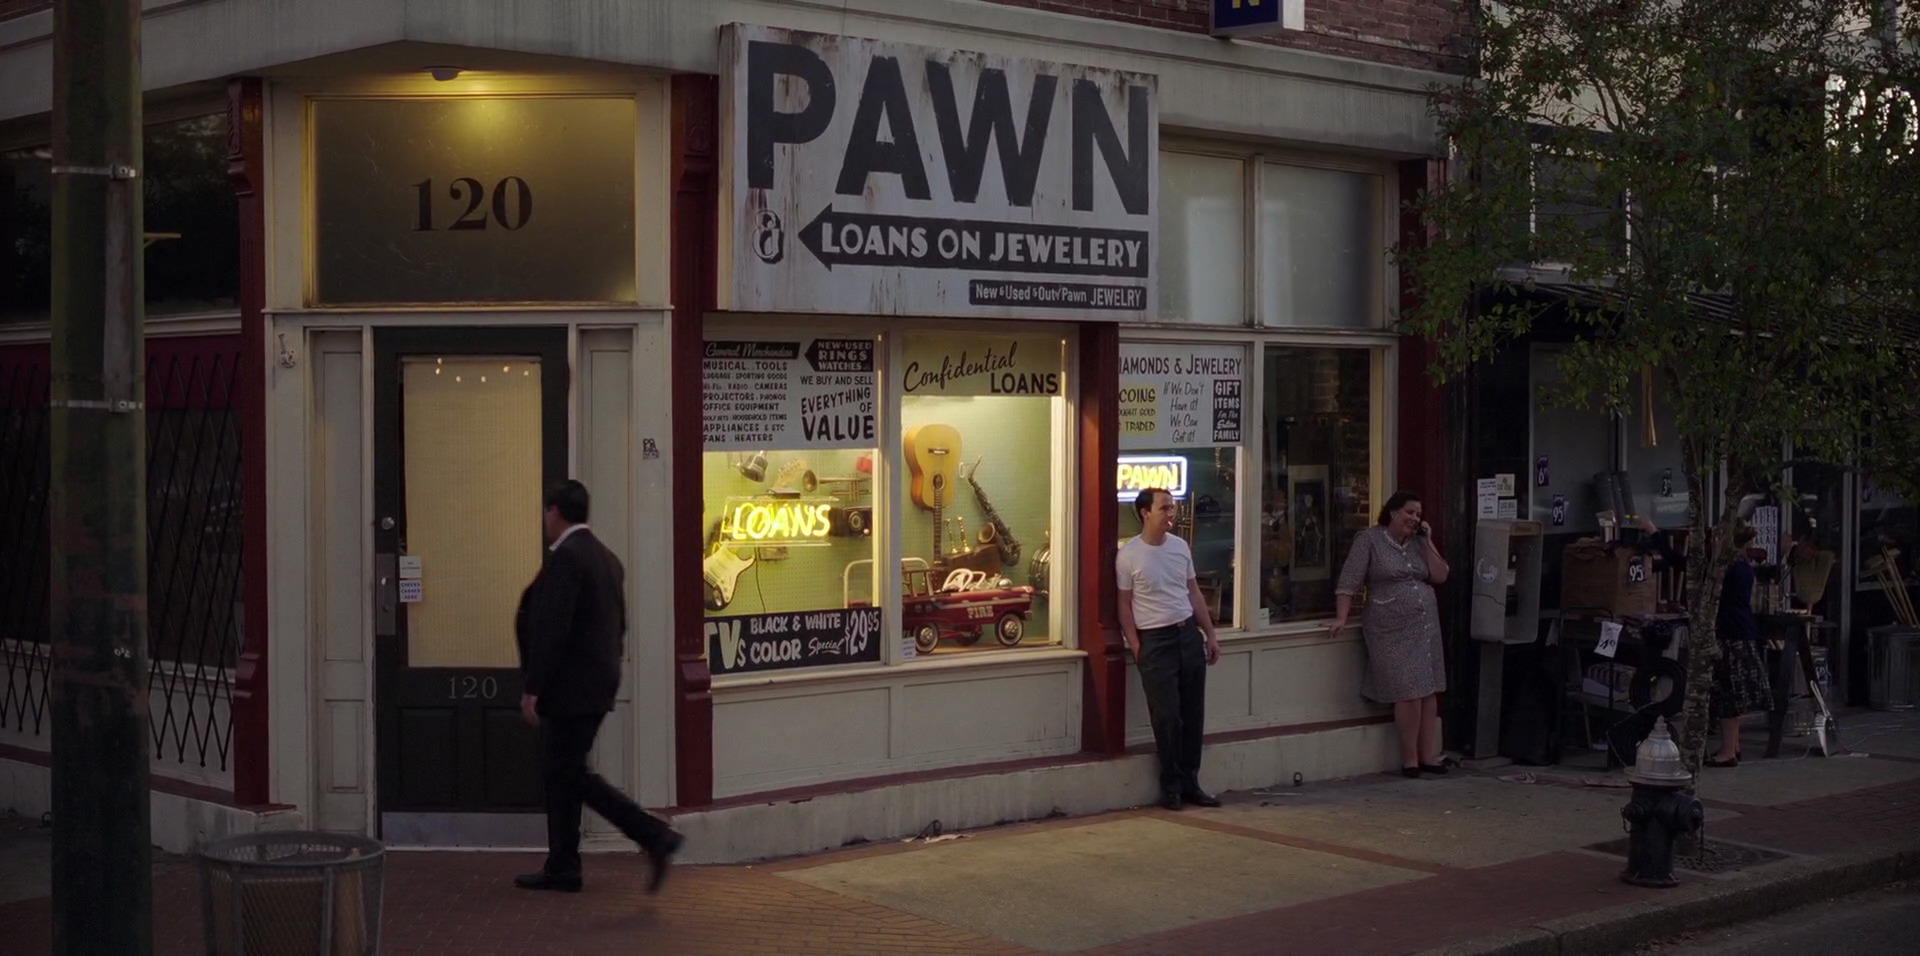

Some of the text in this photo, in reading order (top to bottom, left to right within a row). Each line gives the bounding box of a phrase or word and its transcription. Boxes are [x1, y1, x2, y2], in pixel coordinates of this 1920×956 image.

[748, 40, 1149, 215] PAWN
[412, 176, 533, 232] 120
[821, 221, 1141, 268] LOANS ON JEWELERY
[975, 283, 998, 299] New
[1005, 286, 1031, 300] Used
[1062, 287, 1087, 302] Pawn
[1091, 288, 1141, 306] JEWELRY
[818, 350, 868, 361] RINGS
[703, 361, 788, 371] MUSICAL TOOLS
[818, 361, 862, 371] WATCHES
[903, 341, 1018, 393] Confidential
[1119, 354, 1242, 375] IAMONDS & JEWELERY
[735, 372, 765, 380] SPORTING
[767, 372, 788, 380] GOODS
[800, 375, 873, 385] WE BUY AND SELL
[990, 372, 1058, 394] LOANS
[754, 382, 788, 390] CAMERAS
[1171, 381, 1182, 395] We
[1215, 381, 1240, 397] GIFT
[703, 392, 755, 401] PROJECTORS
[801, 387, 871, 415] EVERYTHING
[1119, 387, 1156, 403] COINS
[703, 402, 779, 411] OFFICE EQUIPMENT
[860, 402, 872, 413] OF
[1170, 397, 1187, 412] Have
[1214, 397, 1240, 409] ITEMS
[703, 423, 760, 432] APPLIANCES
[771, 423, 785, 431] ETC
[801, 414, 874, 442] VALUE
[1125, 421, 1156, 432] TRADED
[1170, 413, 1198, 428] We Can
[703, 433, 773, 442] FANS HEATERS
[1214, 429, 1240, 440] FAMILY
[1117, 463, 1179, 491] PAWN
[731, 503, 832, 540] LOANS
[1629, 564, 1644, 582] 95
[966, 605, 994, 620] FIRE
[750, 613, 841, 635] BLACK & WHITE
[704, 619, 746, 670] TVs
[750, 637, 845, 664] COLOR Special
[448, 677, 498, 700] 120
